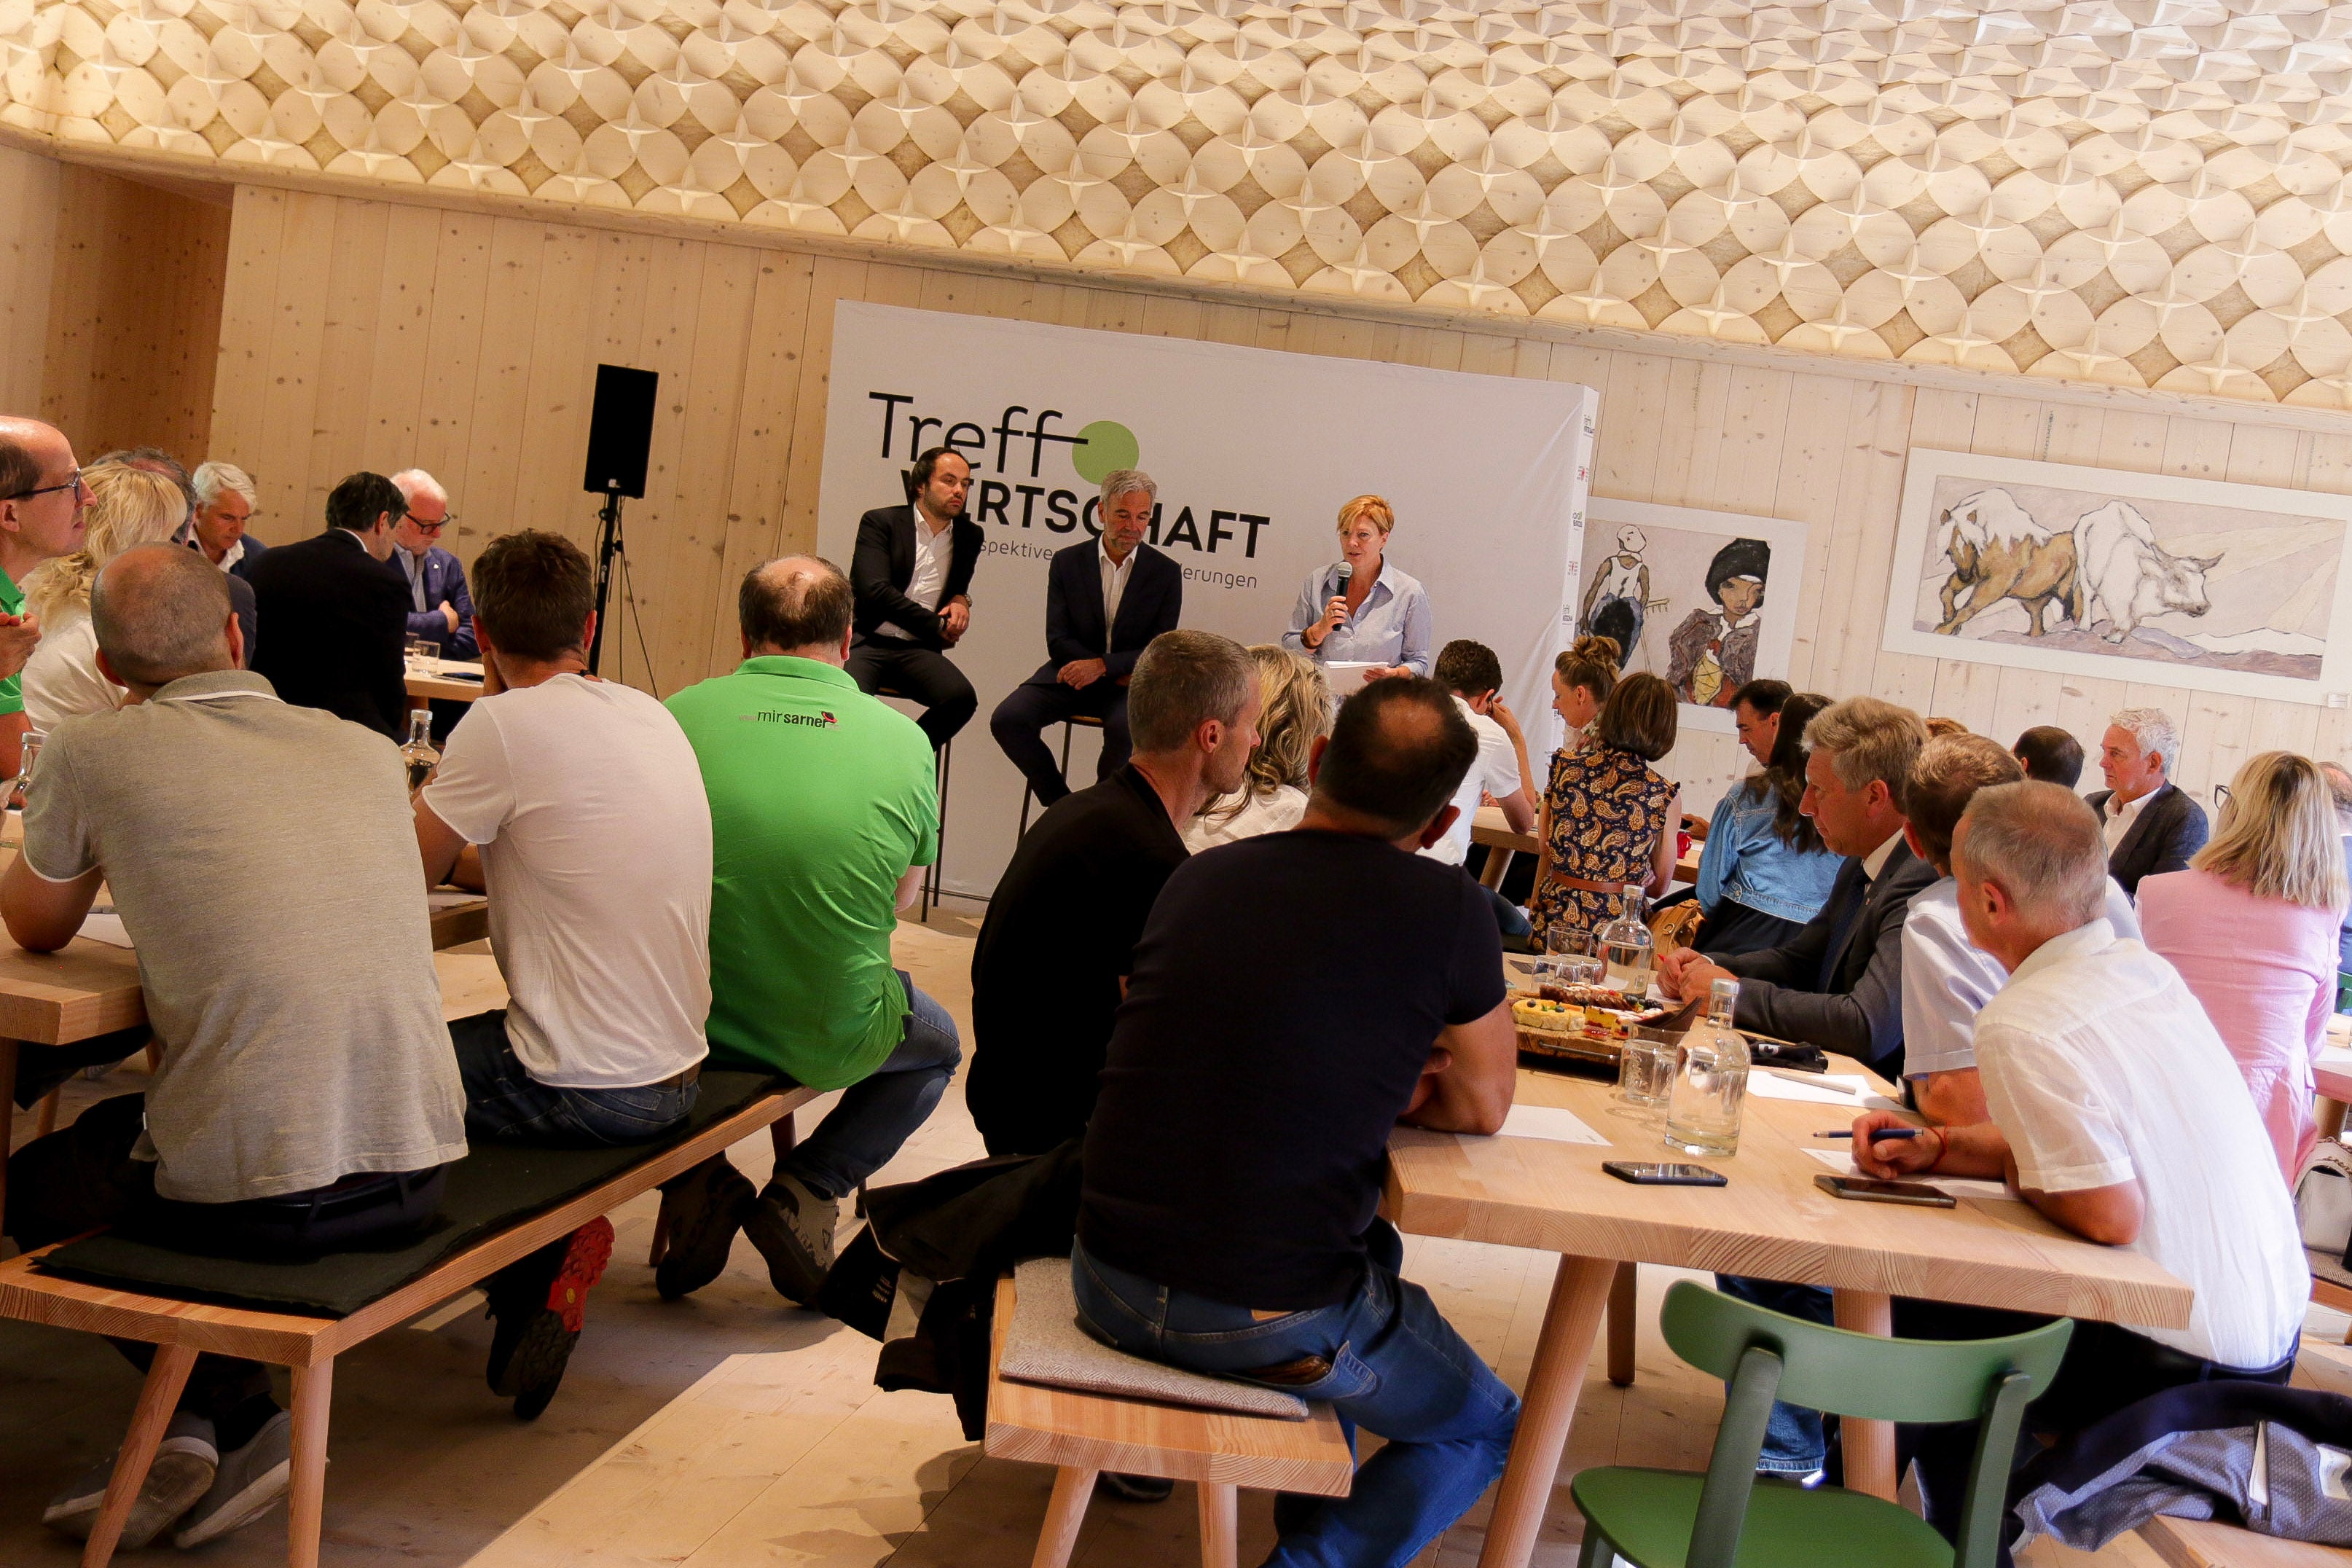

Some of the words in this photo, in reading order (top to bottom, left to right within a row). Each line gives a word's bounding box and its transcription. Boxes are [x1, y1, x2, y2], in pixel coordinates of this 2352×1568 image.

[869, 391, 1089, 478] Treff
[901, 469, 1271, 559] RTSCHAFT
[1180, 563, 1257, 589] erungen
